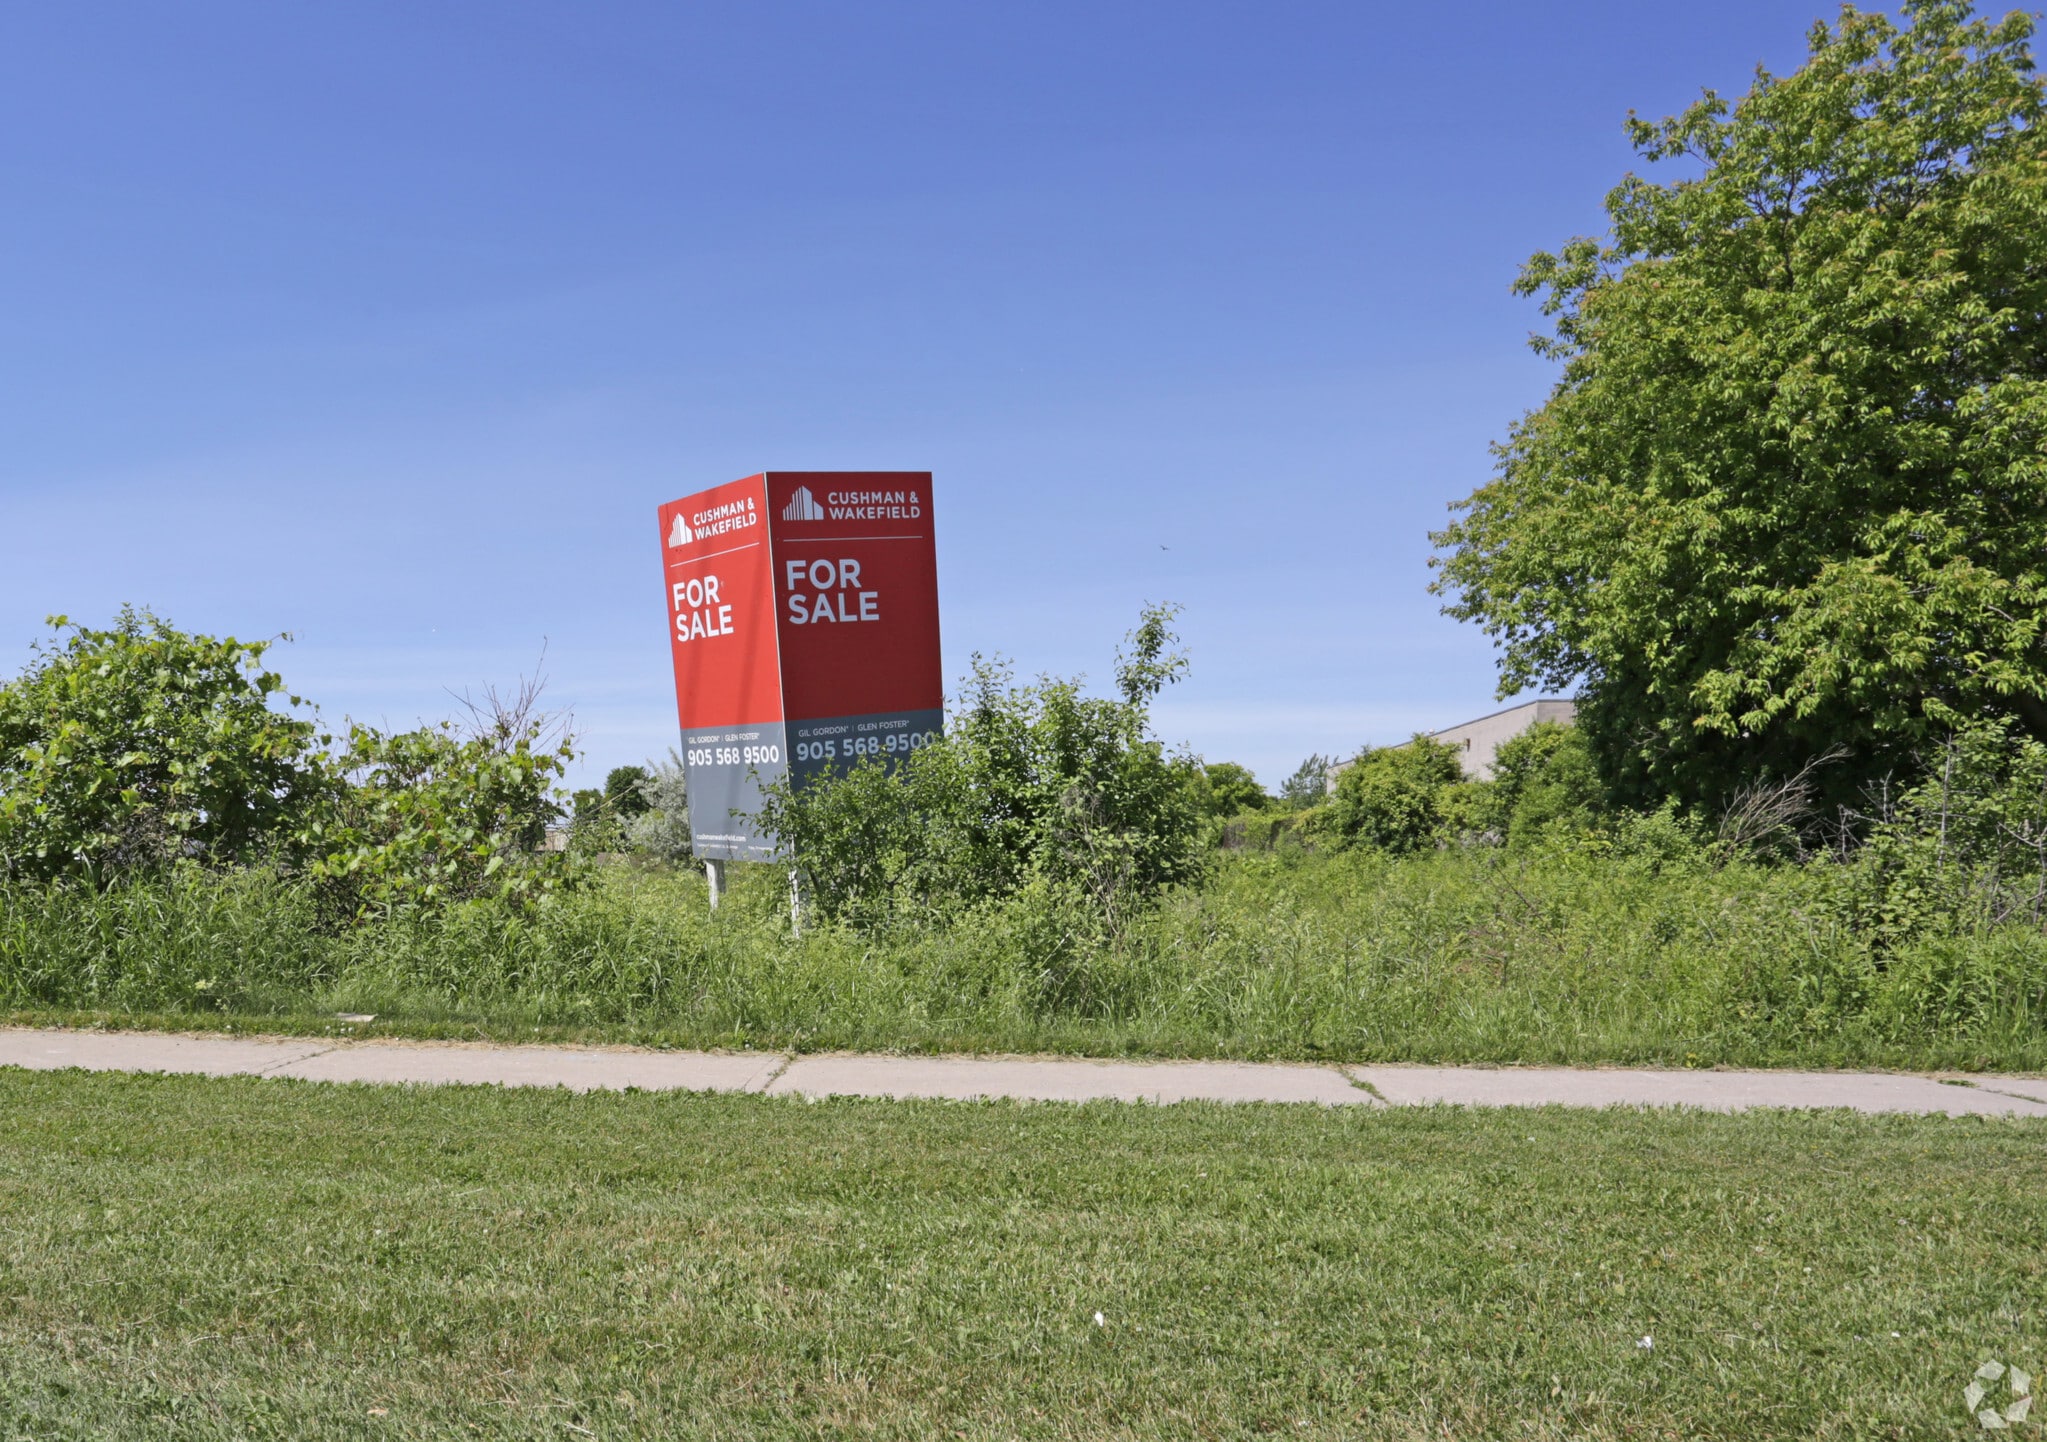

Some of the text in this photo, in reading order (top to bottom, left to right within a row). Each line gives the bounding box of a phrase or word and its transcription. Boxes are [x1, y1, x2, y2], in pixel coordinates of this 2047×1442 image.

[828, 491, 919, 505] CUSHMAN &
[693, 497, 756, 526] CUSHMAN &
[828, 506, 921, 520] WAKEFIELD
[694, 512, 757, 540] WAKEFIELD
[786, 558, 862, 591] FOR
[672, 574, 721, 612] FOR
[788, 591, 880, 625] SALE
[676, 604, 734, 643] SALE
[688, 736, 697, 744] GIL
[724, 733, 739, 742] GLEN
[798, 729, 811, 738] GIL
[857, 723, 878, 732] GLEN
[687, 744, 780, 766] 905 568 9500
[796, 740, 836, 761] 905
[843, 736, 879, 757] 568
